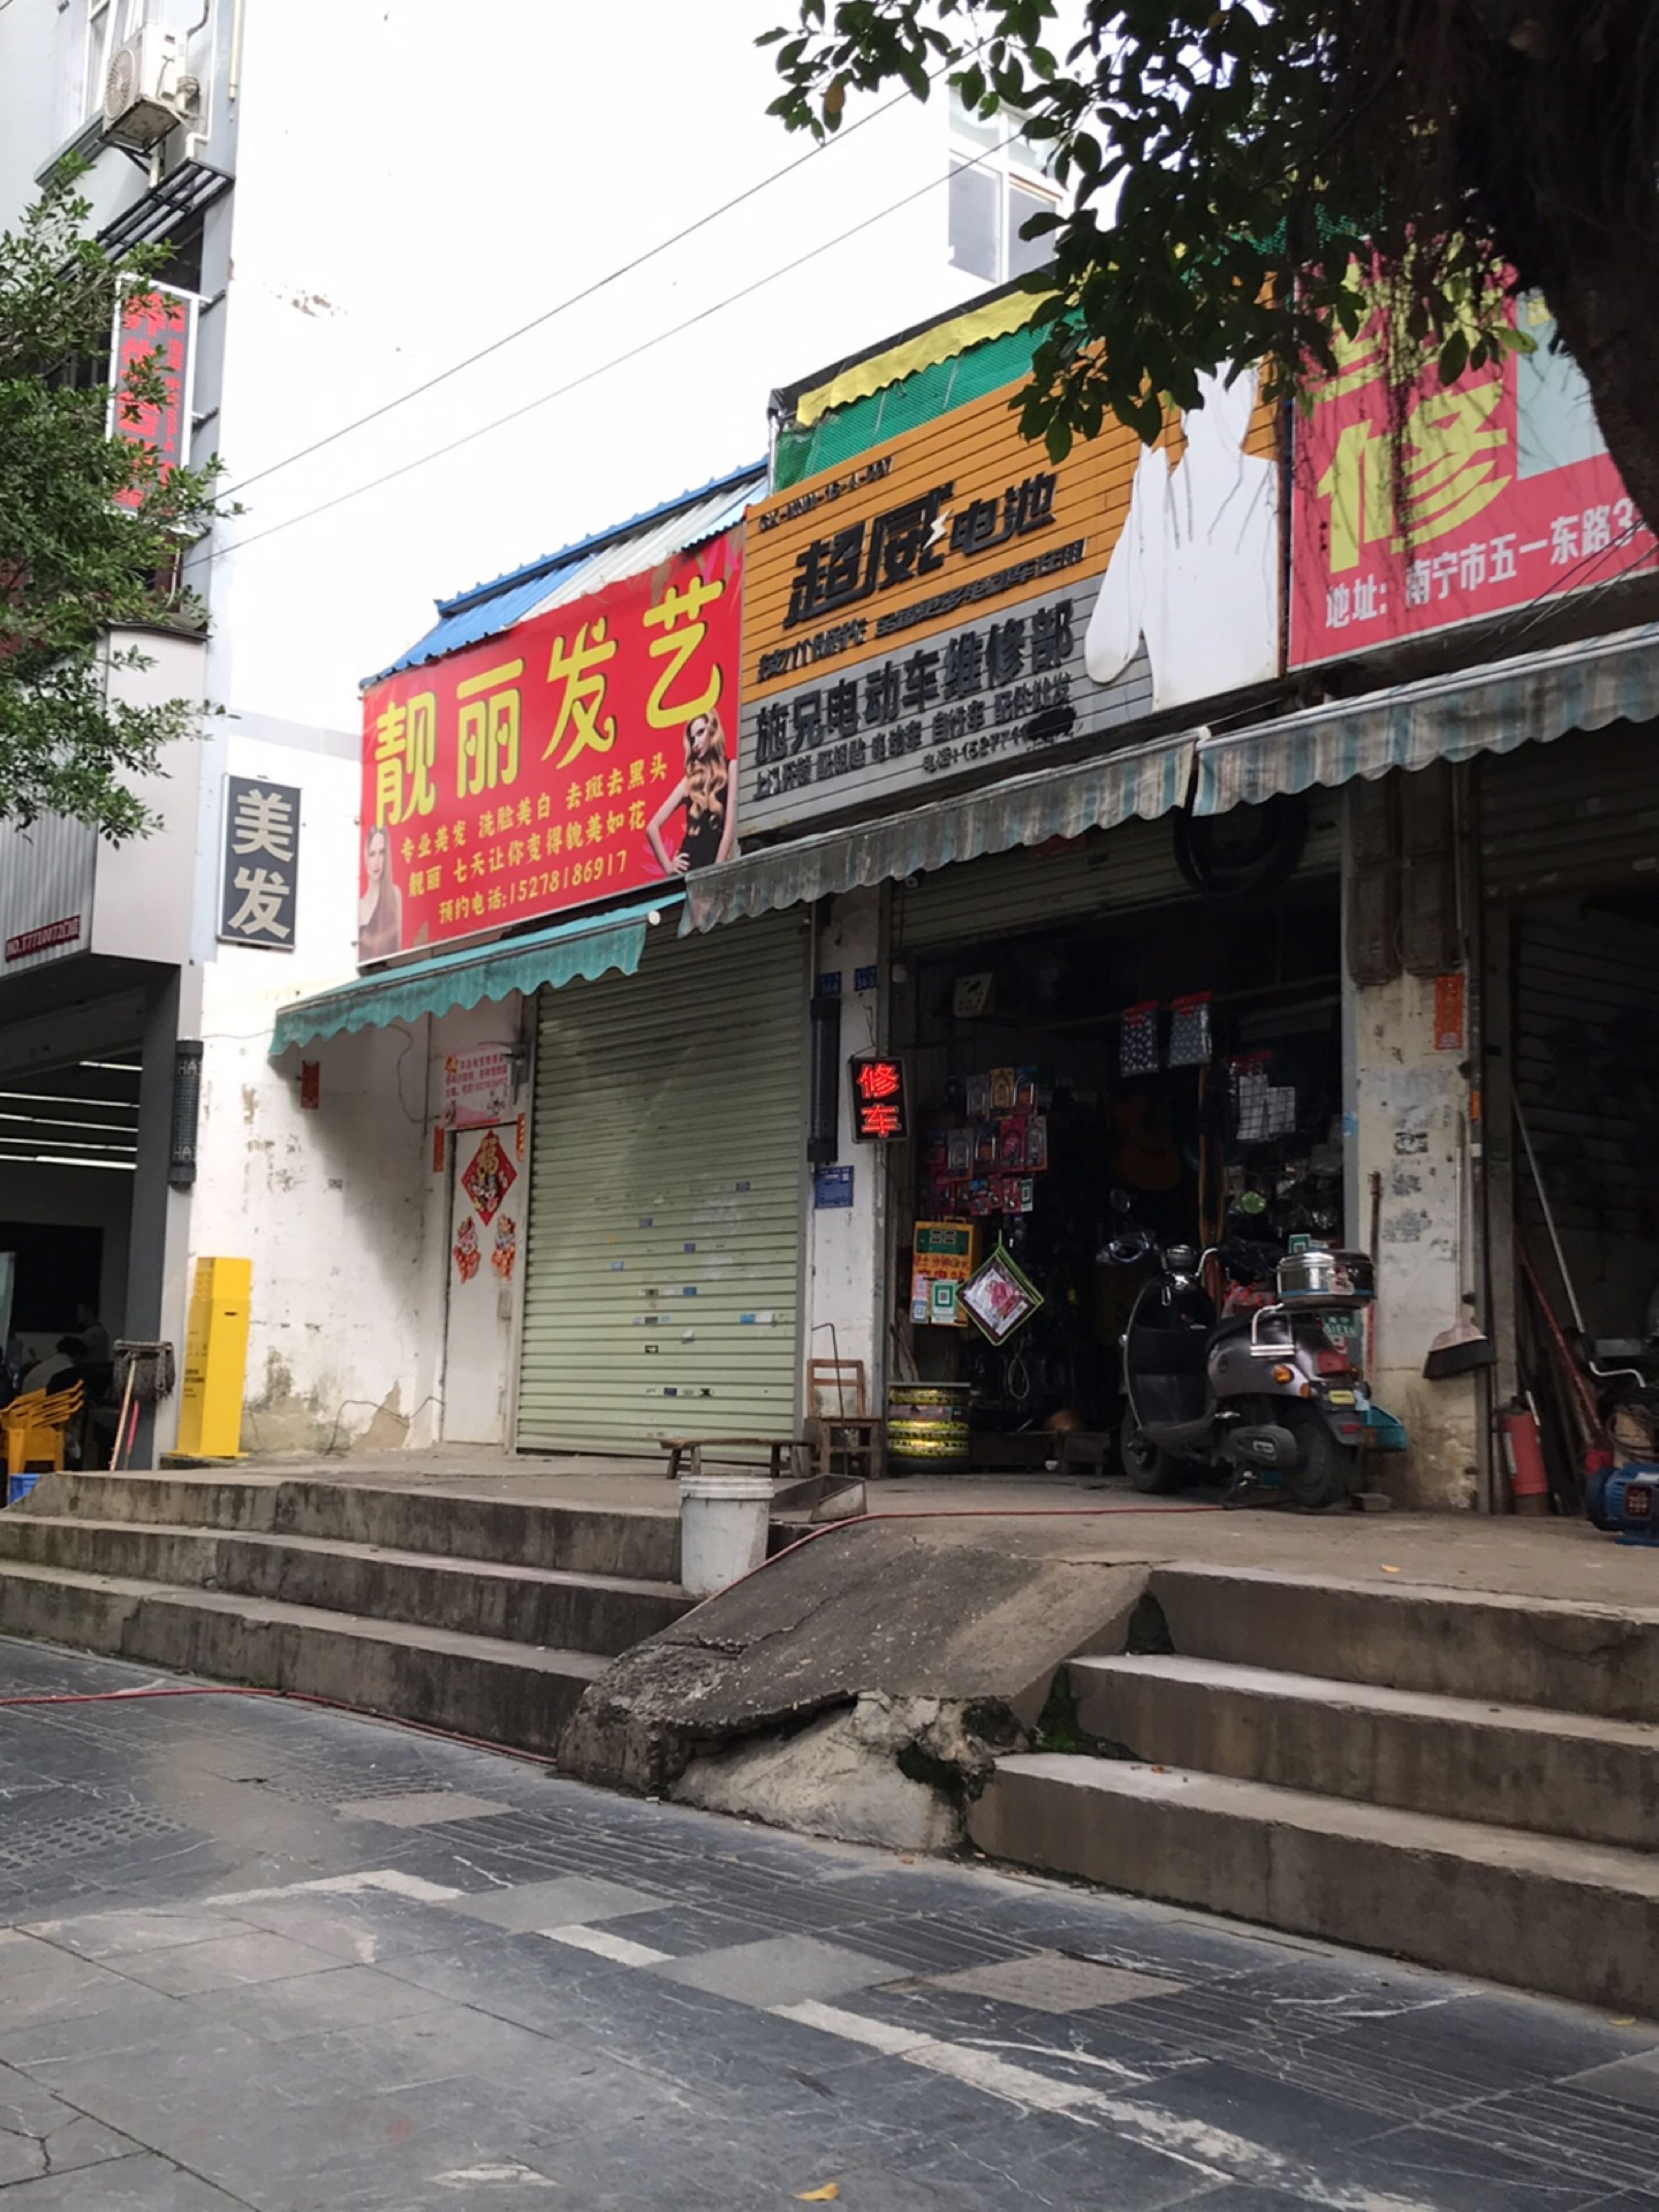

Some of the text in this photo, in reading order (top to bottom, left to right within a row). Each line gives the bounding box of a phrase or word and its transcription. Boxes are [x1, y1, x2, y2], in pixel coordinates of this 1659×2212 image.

[783, 471, 1057, 629] 超威电池
[1326, 497, 1649, 629] 地址：南宁市五一东路3
[374, 576, 725, 830] 靓丽发艺
[228, 789, 294, 939] 美发
[401, 751, 668, 864] 专业美发 洗脸美白 去斑去黑头
[453, 799, 646, 883] 七天让你变得貌美如花
[857, 1062, 901, 1137] 修车
